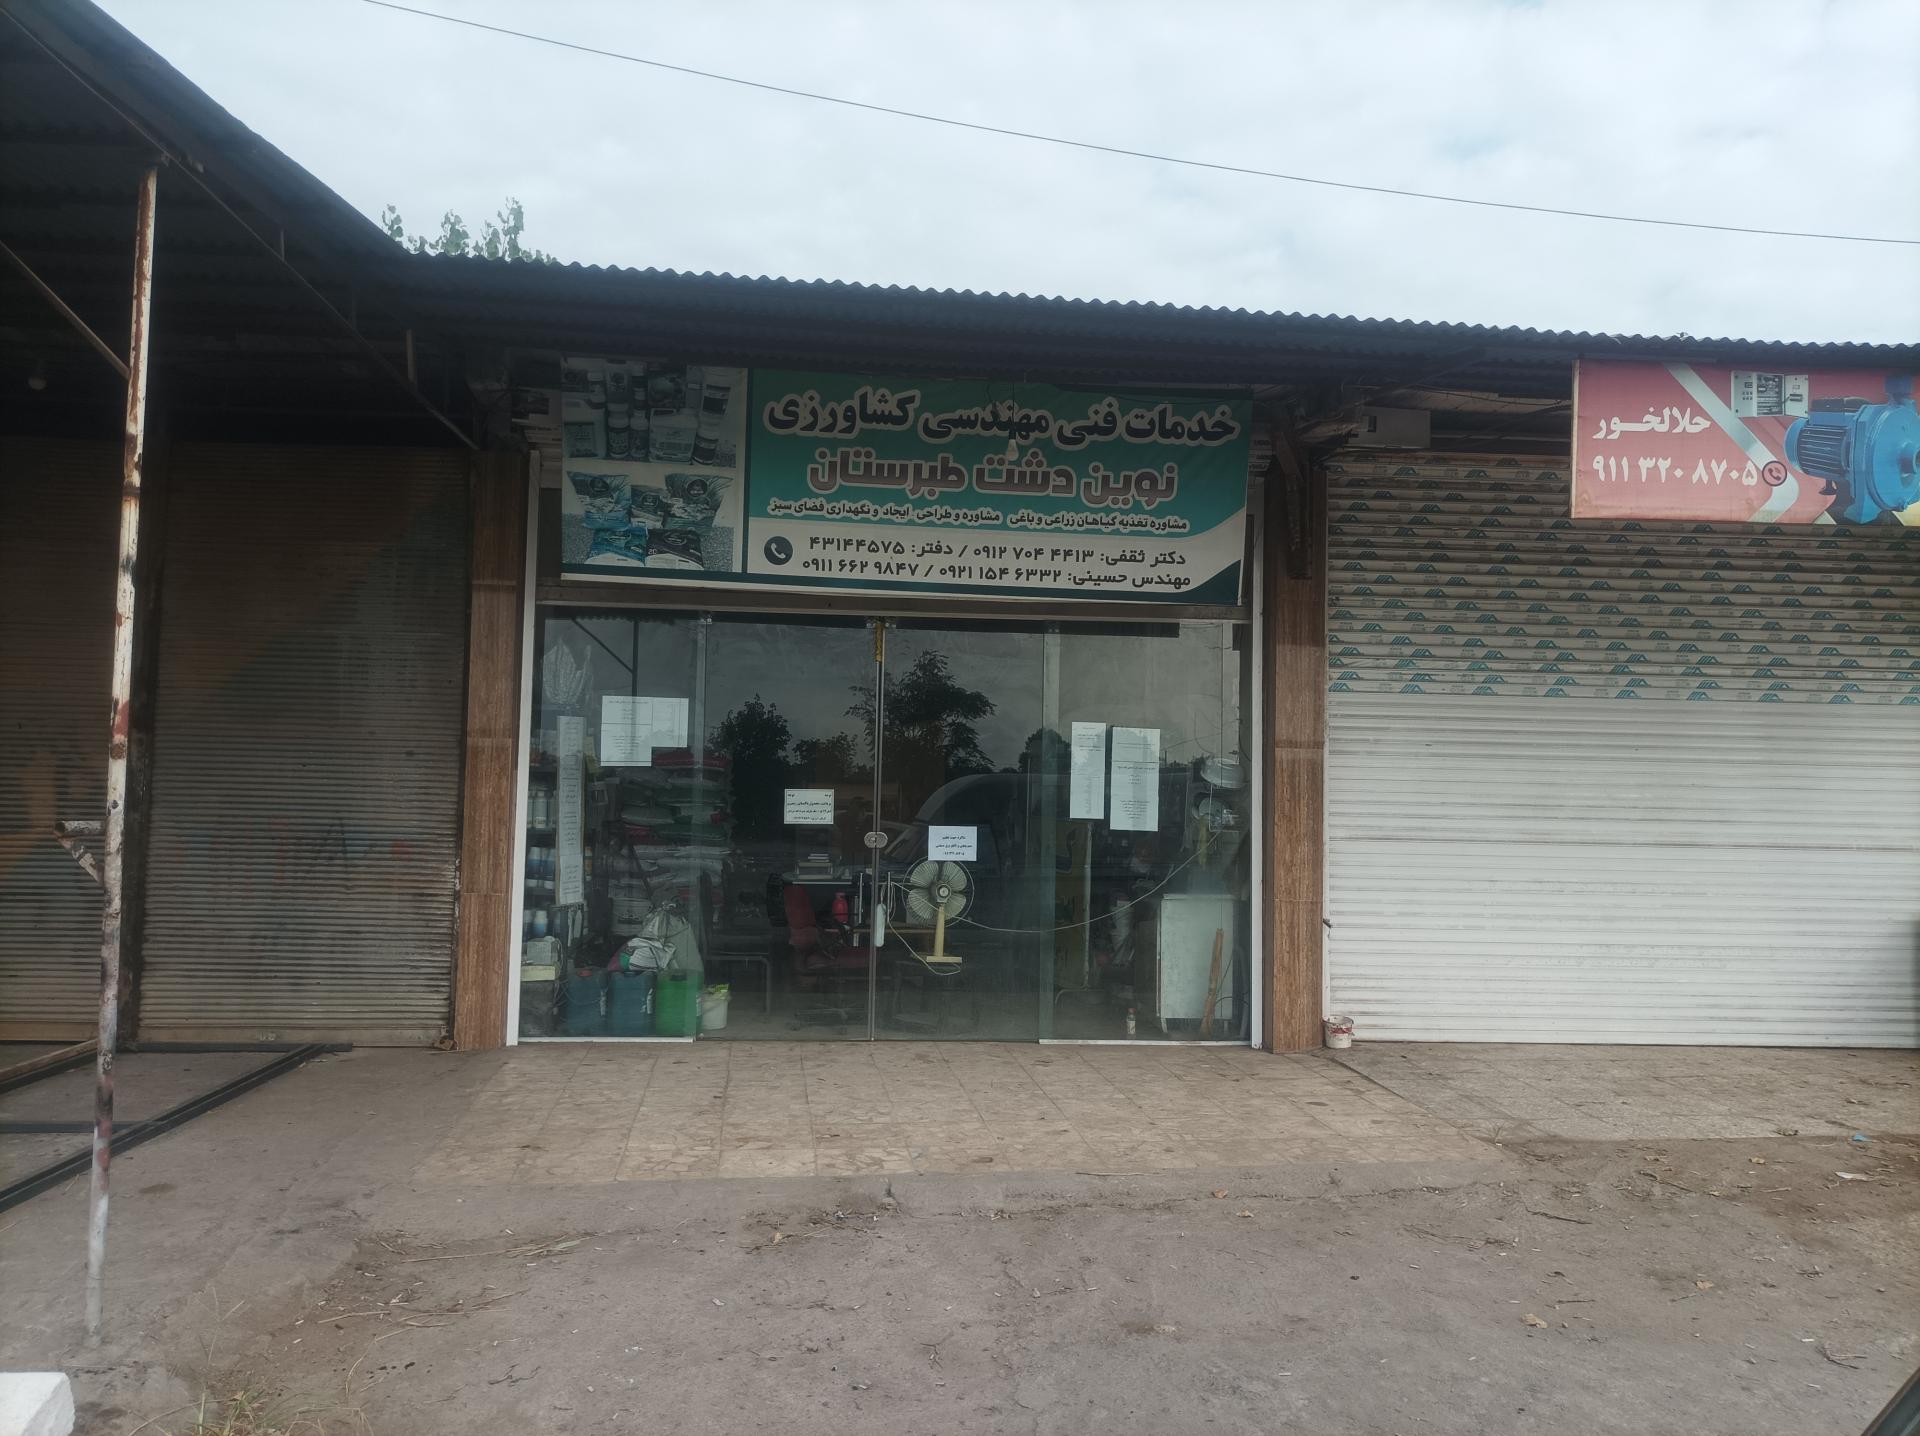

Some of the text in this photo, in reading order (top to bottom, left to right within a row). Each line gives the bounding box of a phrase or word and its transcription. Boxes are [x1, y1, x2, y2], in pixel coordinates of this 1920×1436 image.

[767, 391, 1237, 446] خدمات فنی مهندسی کشاورزی
[1592, 455, 1758, 486] ۹۱۱ ۳۲۰ ۸۷۰۵
[808, 449, 1177, 508] نوین دشت طبرستان
[771, 499, 793, 512] سبز
[794, 500, 825, 514] فضای
[826, 502, 871, 517] نگهداری
[882, 505, 910, 519] ایجاد
[916, 506, 951, 521] طراحی
[962, 508, 1000, 524] مشاوره
[1009, 512, 1034, 525] باغی
[1044, 513, 1075, 528] زراعی
[1076, 514, 1117, 529] گیاهان
[1118, 516, 1148, 530] تغذیه
[1150, 516, 1187, 531] مشاوره
[809, 536, 905, 555] ۴۳۱۴۴۵۷۵
[911, 540, 954, 558] دفتر:
[973, 543, 1007, 559] ۰۹۱۲
[1013, 547, 1045, 561] ۷۰۴
[1050, 548, 1094, 563] ۴۴۱۳
[1100, 549, 1146, 566] ثقفی:
[1149, 550, 1186, 568] دکتر
[802, 557, 833, 572] ۰۹۱۱
[838, 559, 869, 574] ۶۶۲
[873, 561, 919, 577] ۹۸۴۷
[939, 564, 973, 580] ۰۹۲۱
[979, 566, 1009, 580] ۱۵۴
[1014, 566, 1062, 581] ۶۳۳۲
[1067, 569, 1128, 587] حسینی:
[1131, 572, 1191, 590] مهندس
